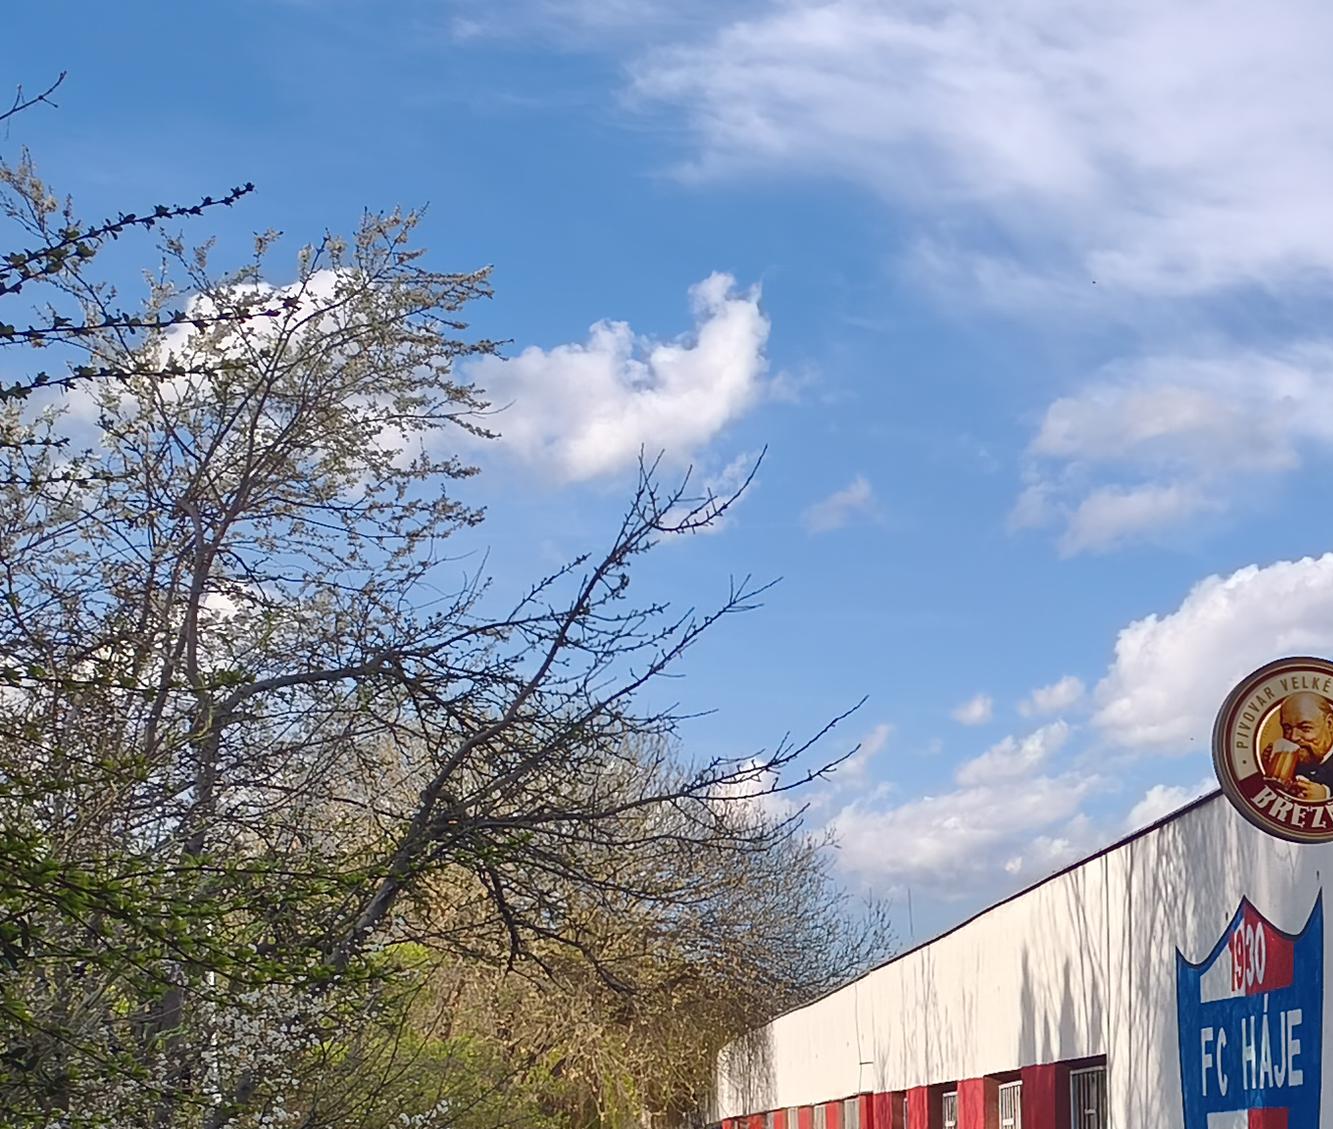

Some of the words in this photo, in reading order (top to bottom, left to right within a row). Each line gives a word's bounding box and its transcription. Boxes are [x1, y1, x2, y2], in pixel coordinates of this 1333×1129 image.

[1236, 686, 1276, 750] PIVOVAR
[1280, 676, 1332, 694] VELKÉ
[1229, 921, 1268, 993] 1930
[1200, 1026, 1230, 1098] FC
[1241, 994, 1305, 1091] HÁJE
